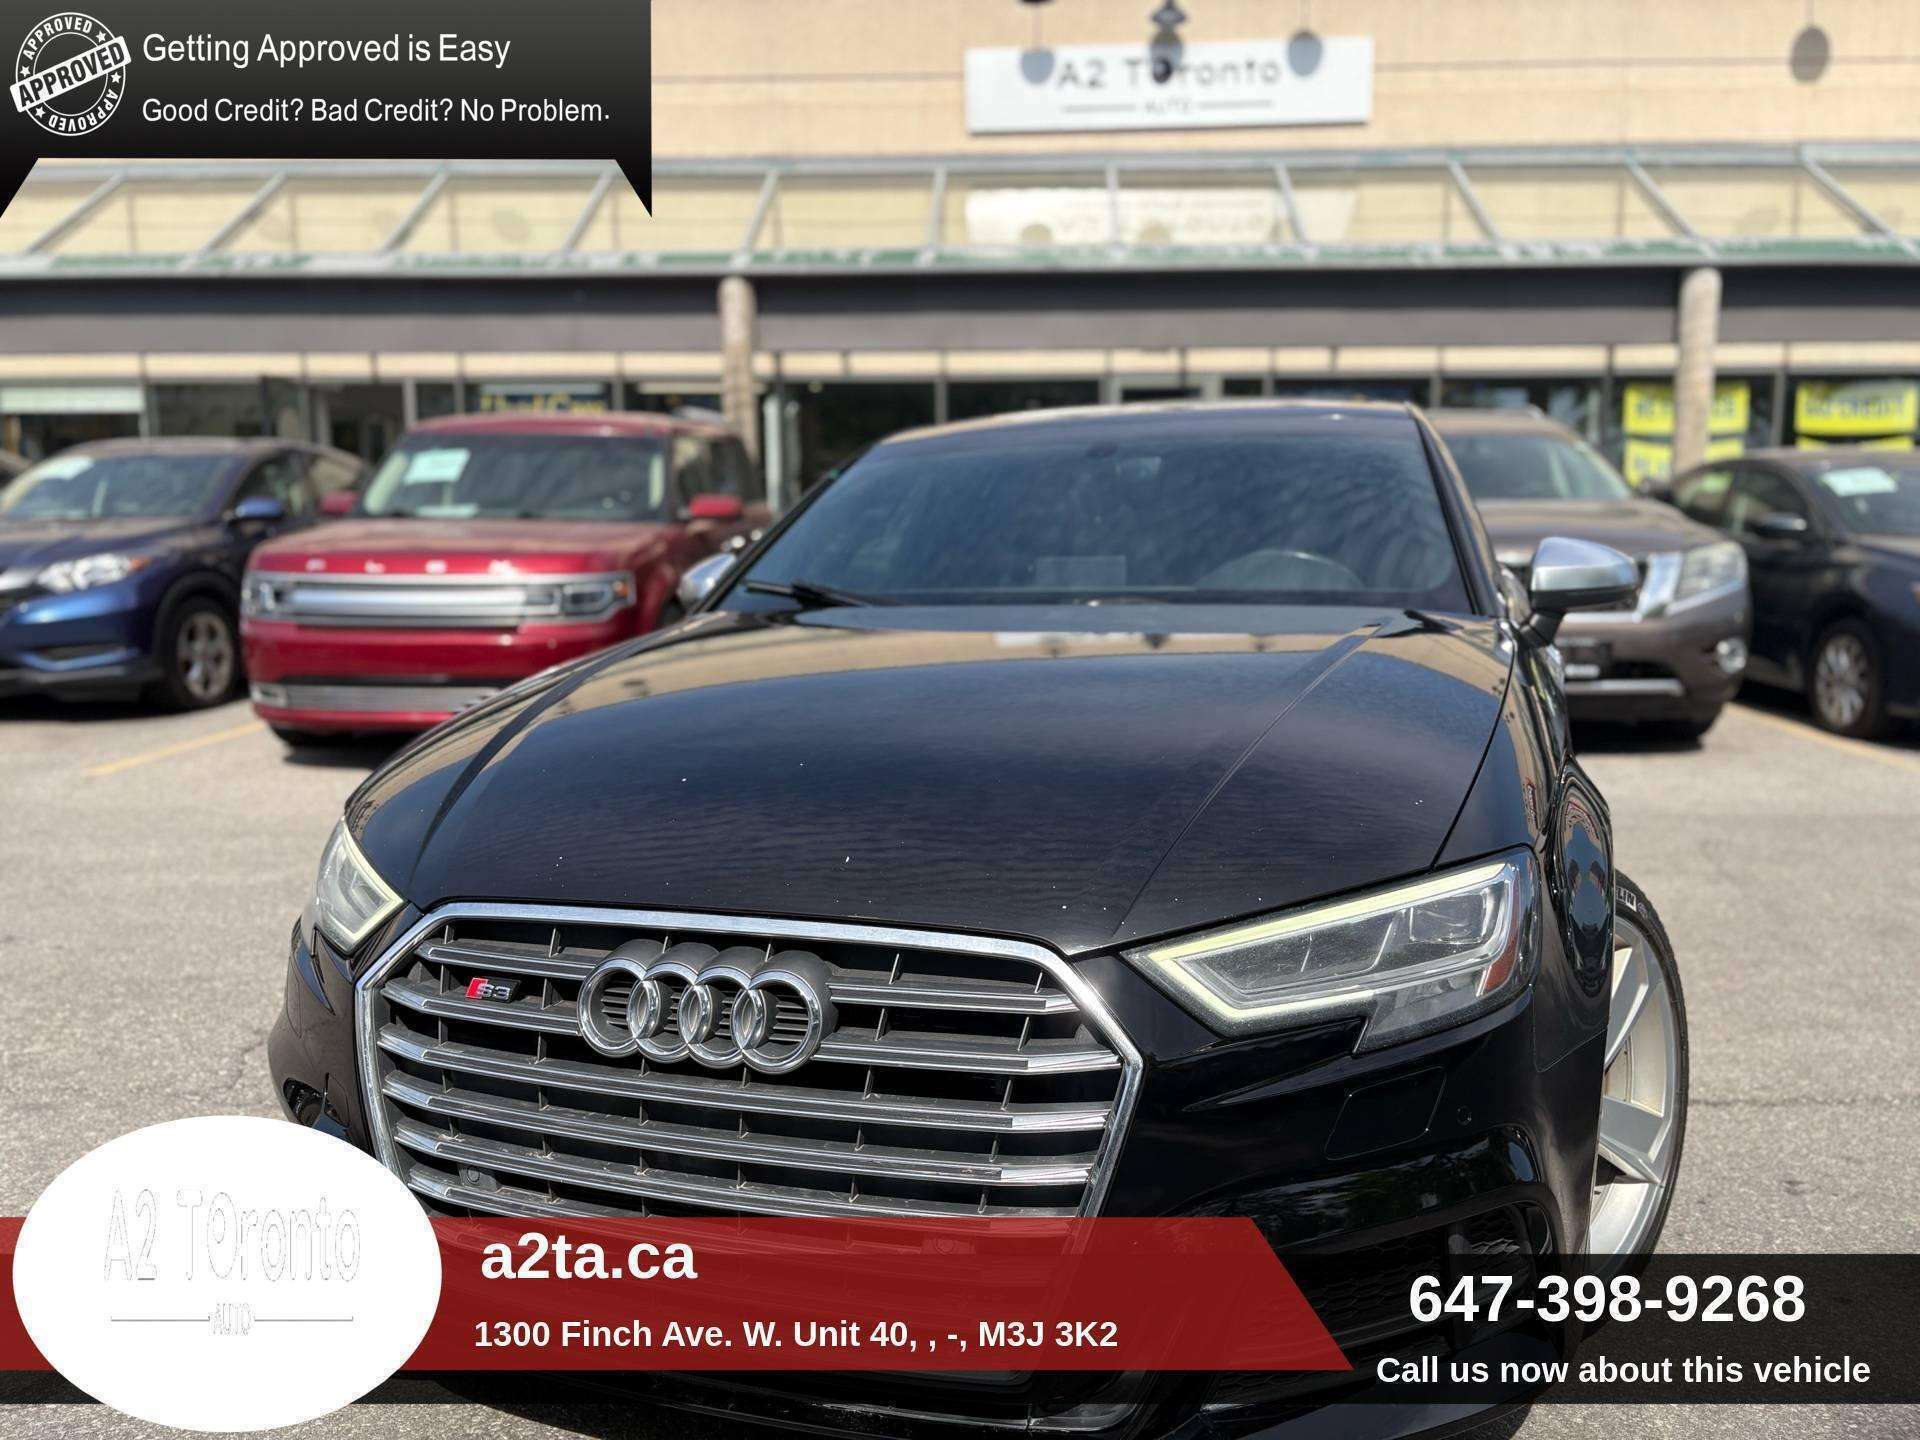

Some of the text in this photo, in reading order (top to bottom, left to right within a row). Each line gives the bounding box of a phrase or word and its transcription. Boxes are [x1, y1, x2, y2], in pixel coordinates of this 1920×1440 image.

[1057, 56, 1283, 88] A2 Tronto
[467, 977, 511, 1001] S3
